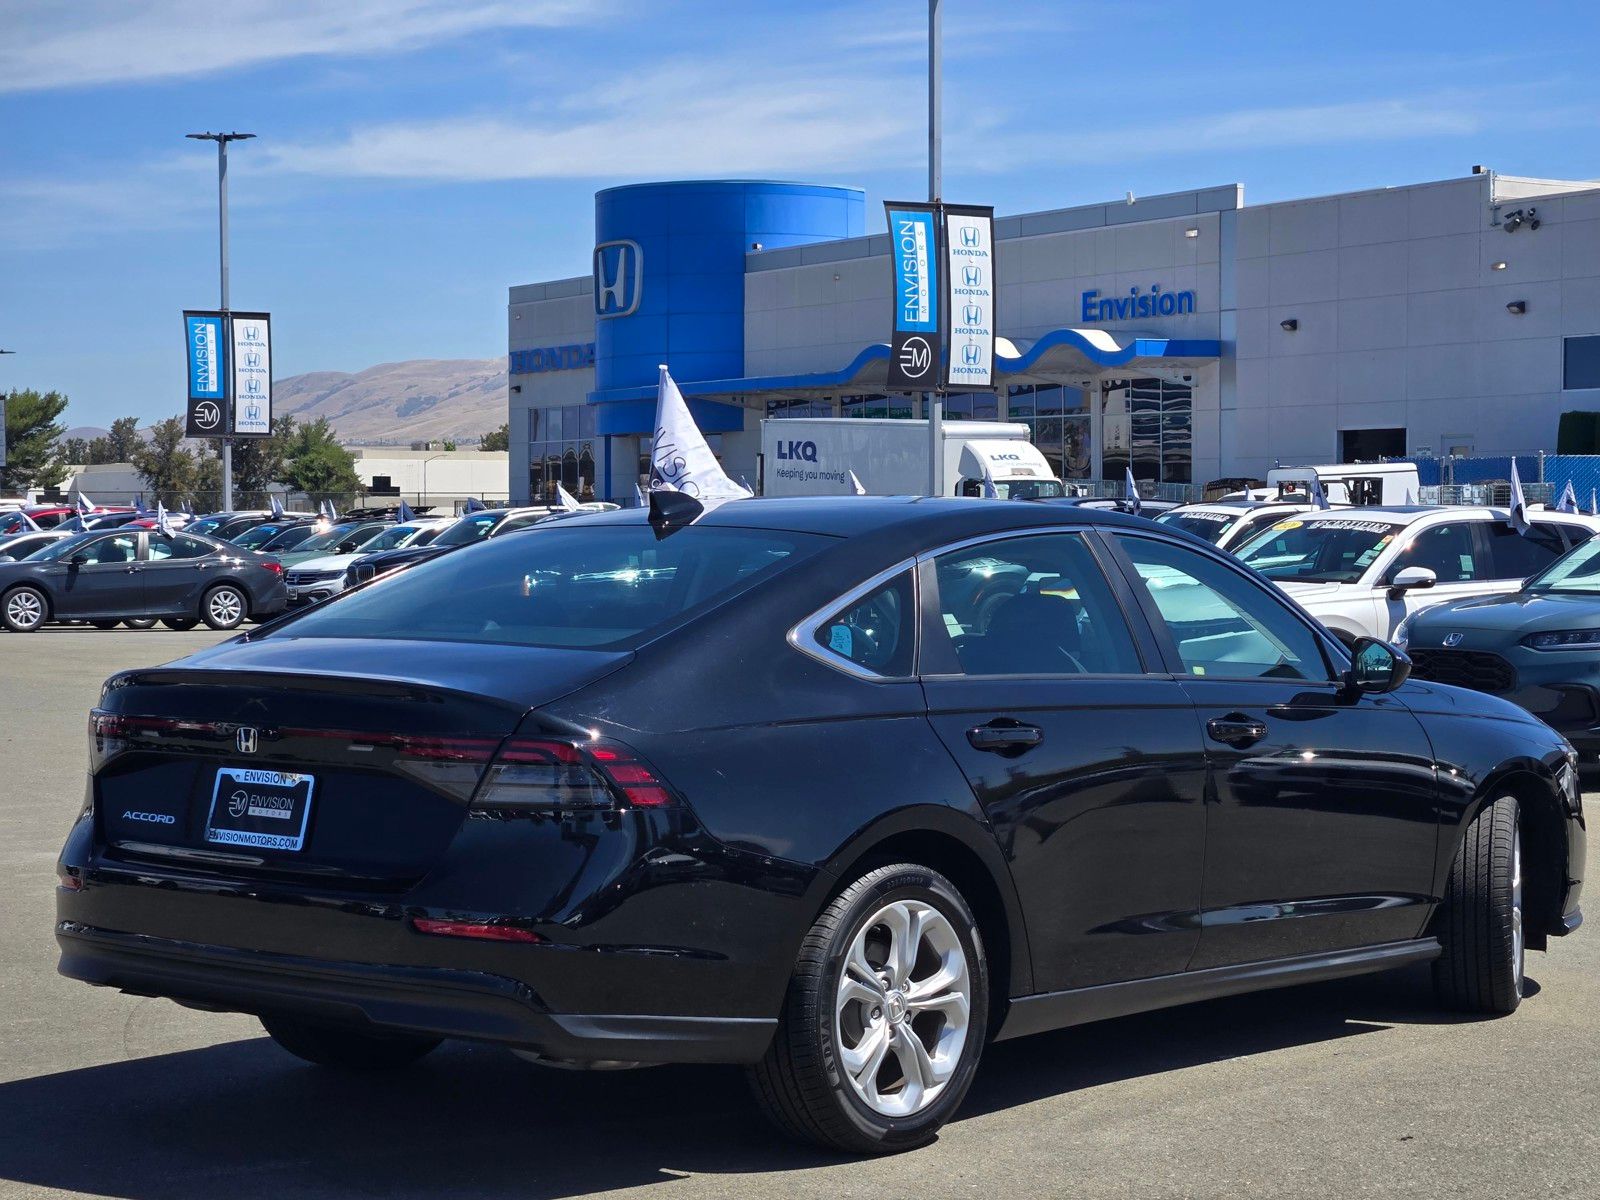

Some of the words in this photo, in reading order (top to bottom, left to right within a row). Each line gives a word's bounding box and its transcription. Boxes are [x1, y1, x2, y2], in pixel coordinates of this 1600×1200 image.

[953, 248, 988, 257] HONDA
[900, 221, 919, 323] ENVISION
[918, 231, 928, 314] MOTORS
[954, 288, 990, 297] HONDA
[1082, 285, 1193, 322] Envision
[954, 327, 989, 336] HONDA
[194, 322, 209, 392] ENVISION
[953, 367, 988, 375] HONDA
[777, 440, 818, 462] LKQ
[776, 468, 804, 481] Keeping
[804, 471, 818, 481] you
[819, 470, 846, 484] moving
[244, 771, 287, 785] ENVISION
[249, 795, 294, 810] ENVISION
[122, 810, 175, 824] ACCORD
